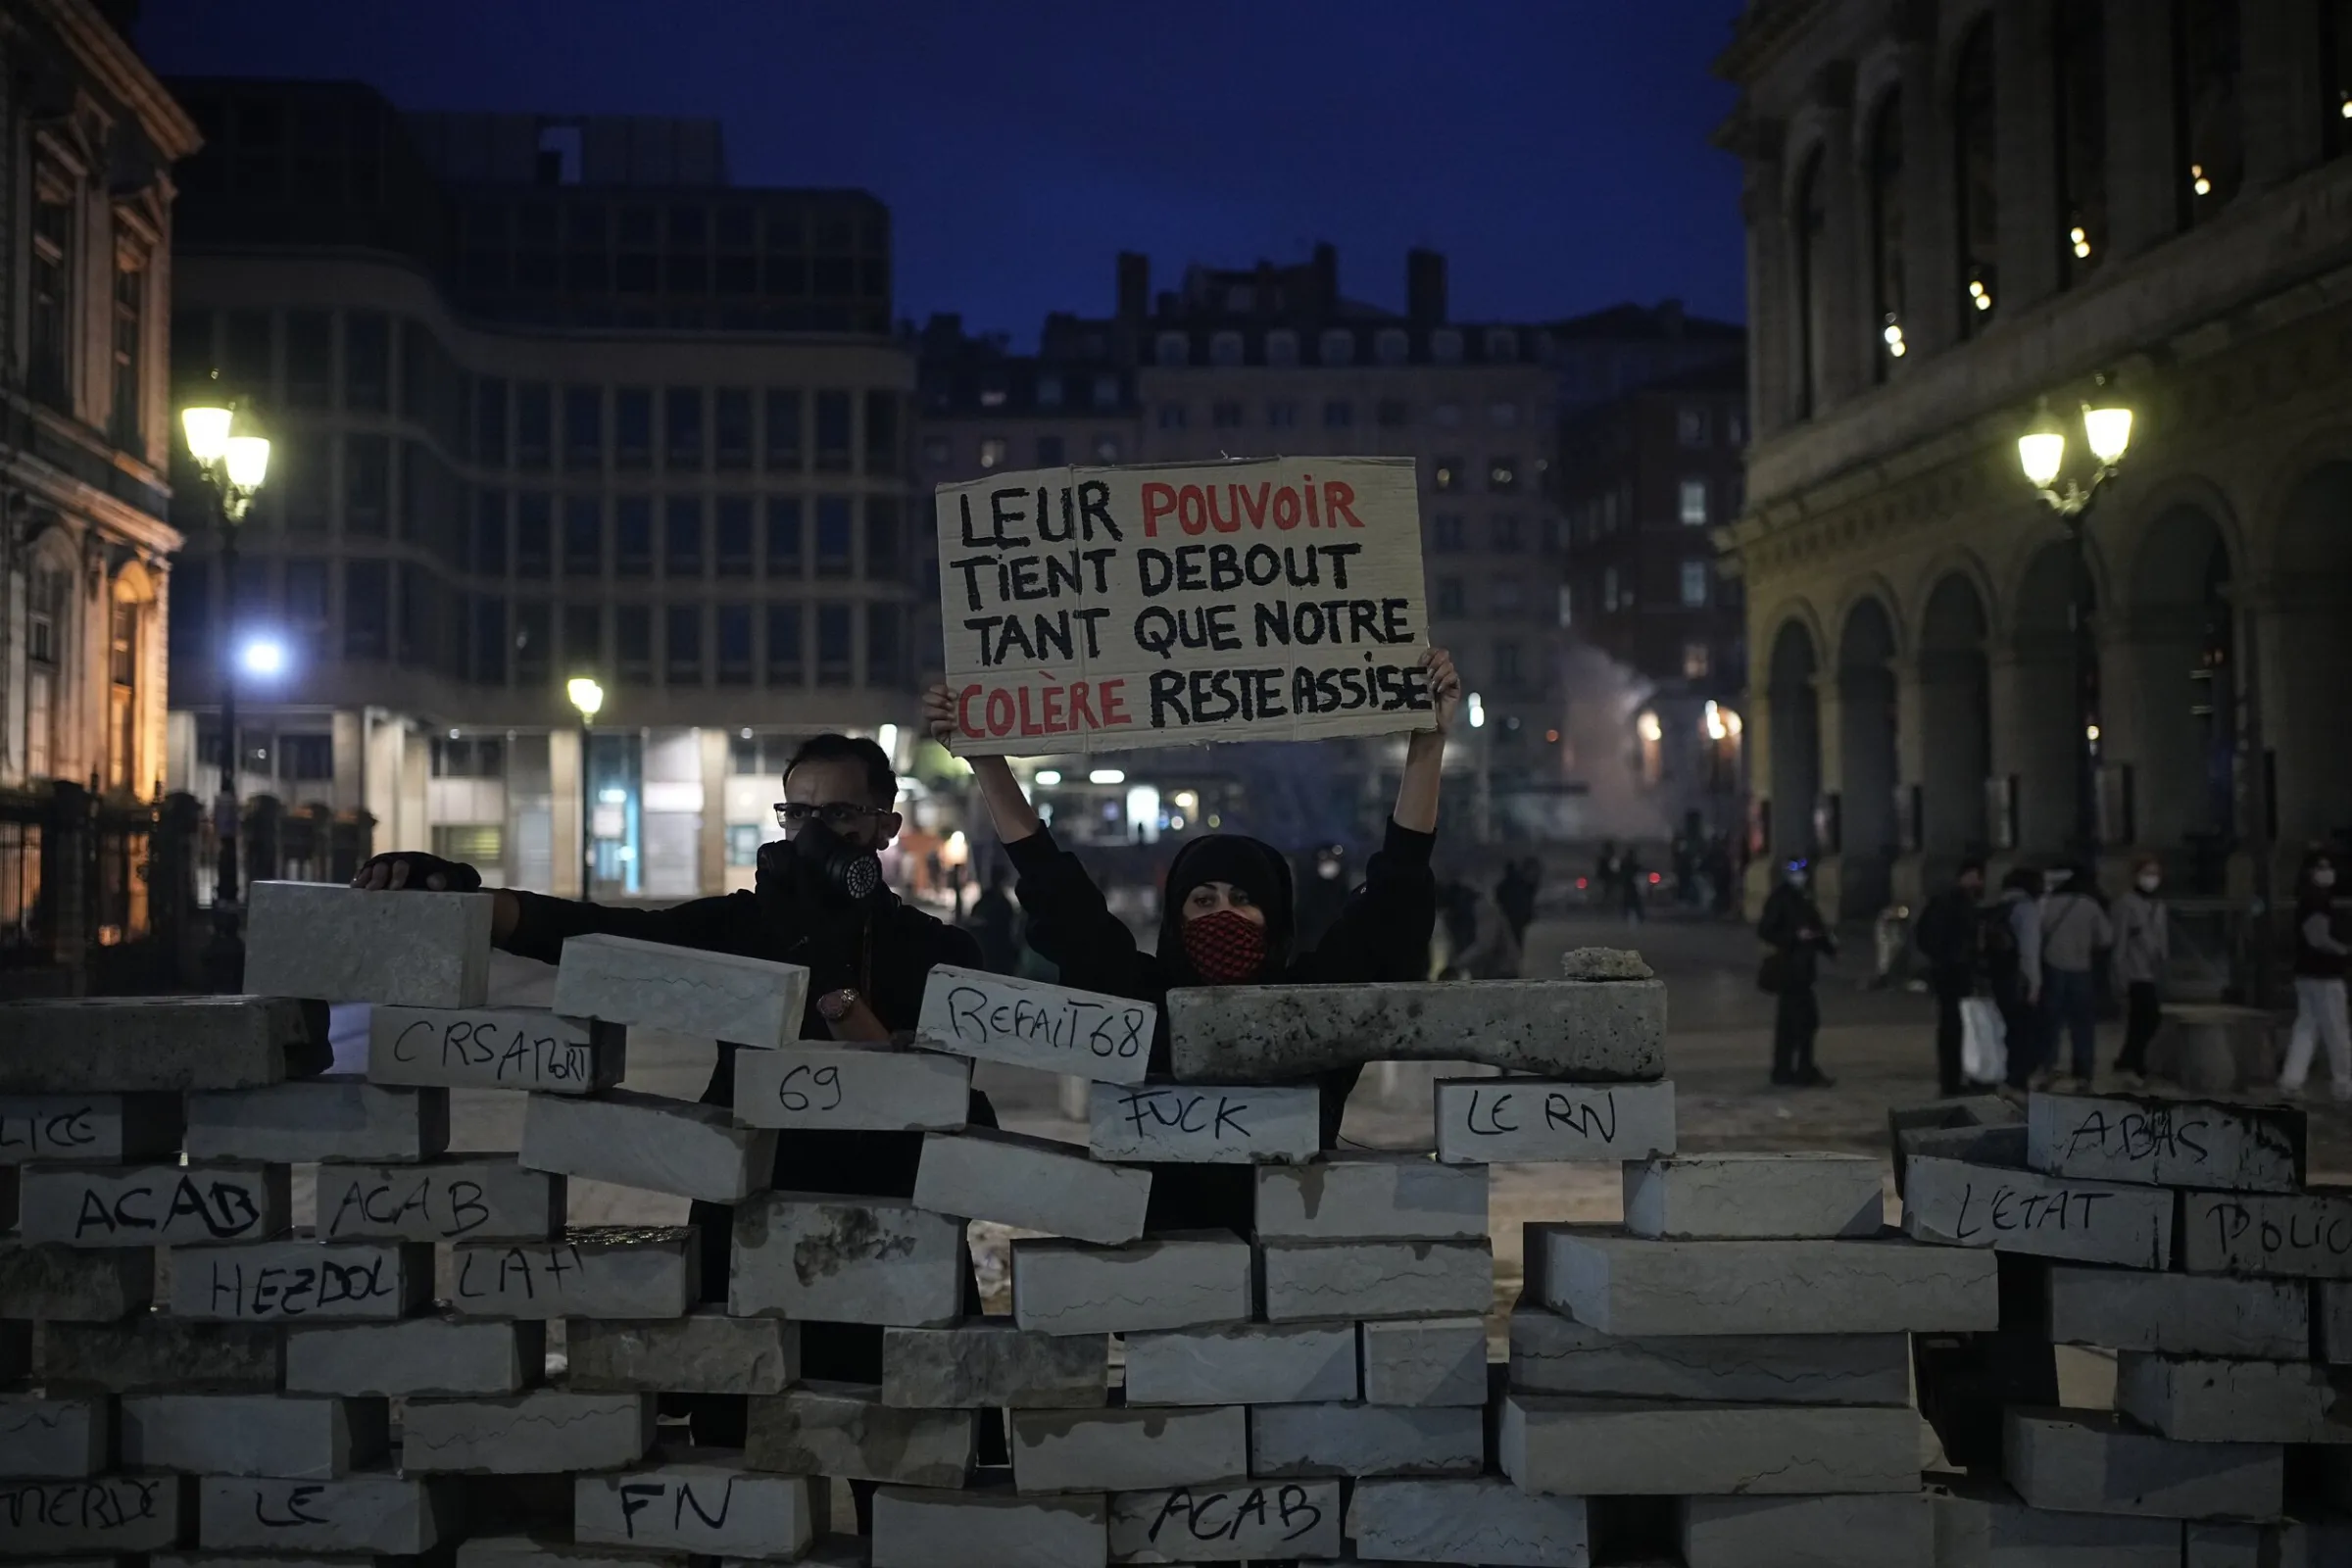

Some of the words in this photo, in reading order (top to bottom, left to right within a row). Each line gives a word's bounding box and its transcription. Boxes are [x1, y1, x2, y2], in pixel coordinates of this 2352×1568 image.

[960, 480, 1123, 548] LEUR
[1141, 474, 1365, 537] POUVOIR
[950, 548, 1116, 611] TIENT
[1137, 542, 1362, 597] DEBOUT
[964, 608, 1110, 666] TANT
[1134, 604, 1243, 659] QUE
[1254, 598, 1415, 648] NOTRE
[958, 670, 1133, 738] COLÈRE
[1150, 668, 1288, 728] RESTE
[1293, 651, 1433, 714] ASSISE
[1090, 1008, 1144, 1057] 68
[779, 1064, 842, 1111] 69
[1118, 1090, 1251, 1140] FUCK
[1468, 1090, 1519, 1136] LE
[1544, 1093, 1616, 1143] RN
[75, 1174, 260, 1239] ACAB
[329, 1177, 490, 1237] ACAB
[256, 1486, 329, 1527] LE
[620, 1477, 732, 1539] FN
[1149, 1484, 1321, 1542] ACAB
